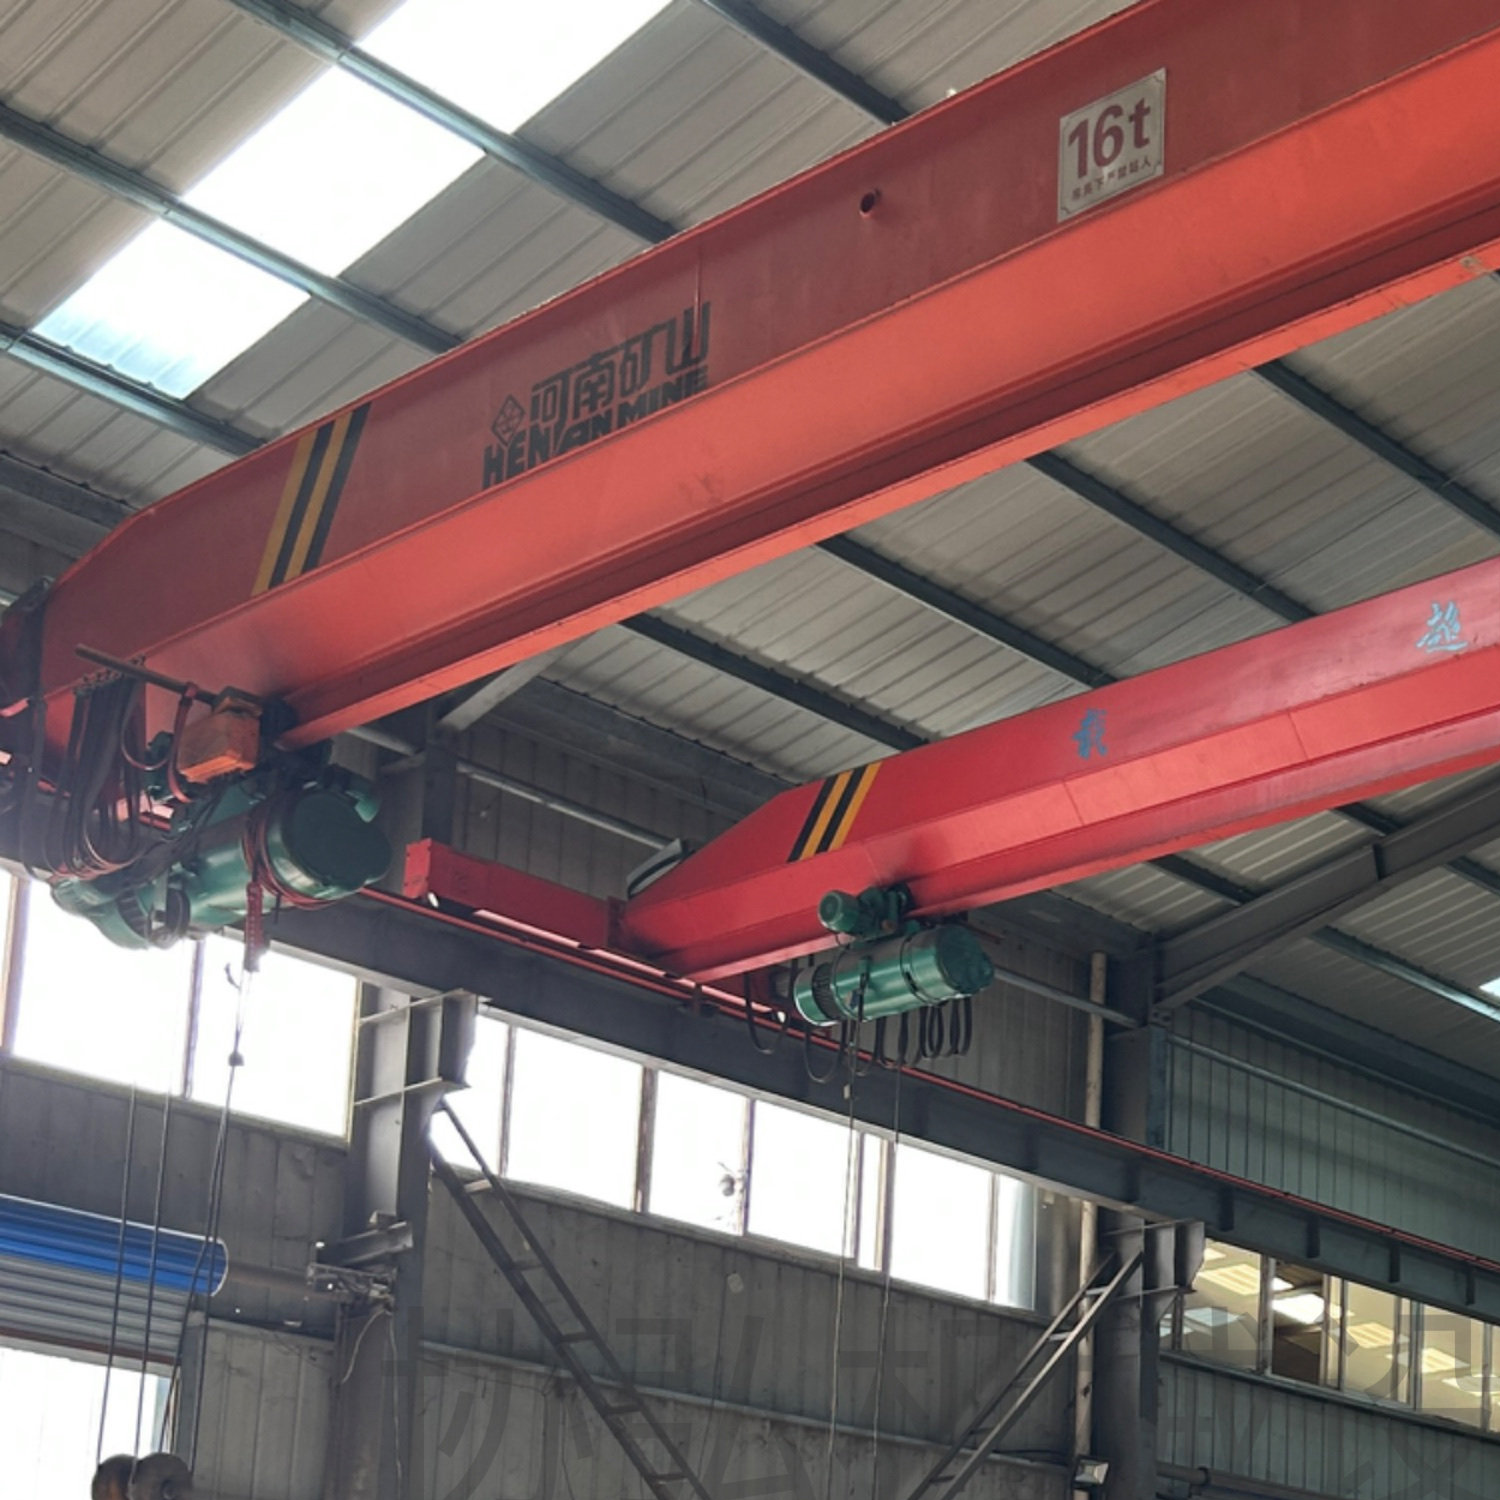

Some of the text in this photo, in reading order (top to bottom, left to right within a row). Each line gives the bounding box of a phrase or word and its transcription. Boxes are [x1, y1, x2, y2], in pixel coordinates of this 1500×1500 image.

[1068, 98, 1151, 178] 16t
[481, 364, 709, 491] HENAN MINE
[530, 301, 710, 450] 河南矿山
